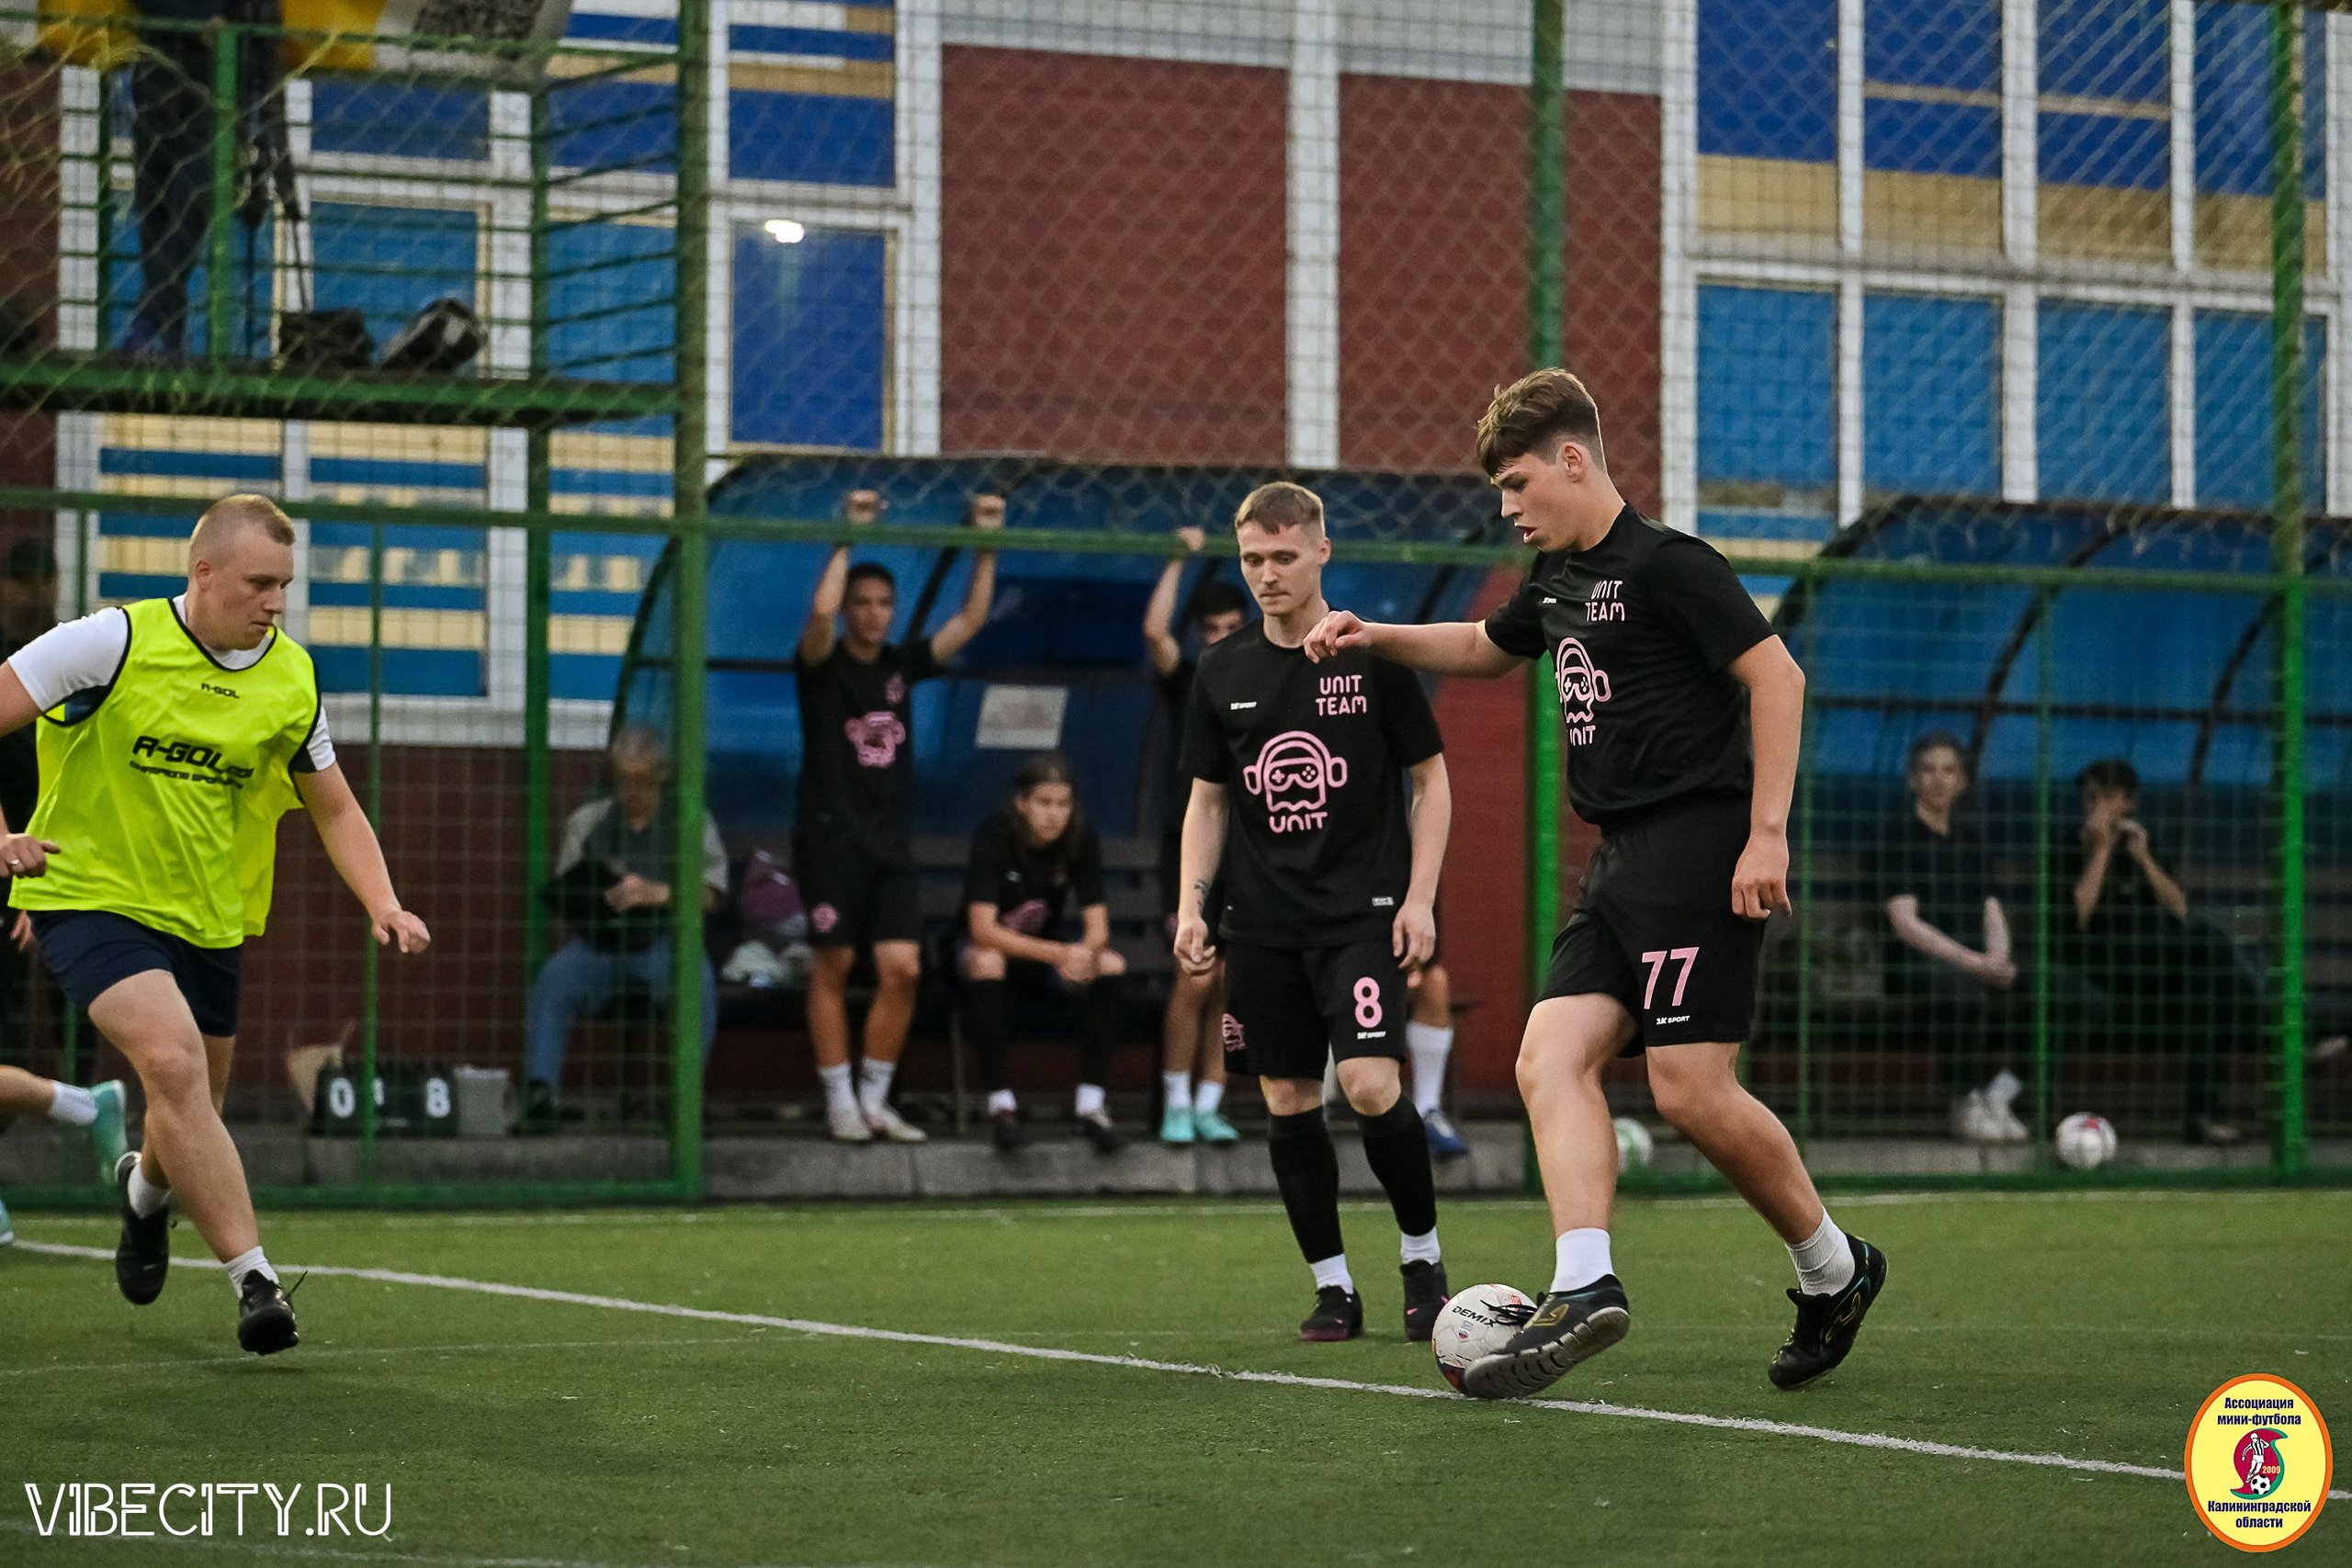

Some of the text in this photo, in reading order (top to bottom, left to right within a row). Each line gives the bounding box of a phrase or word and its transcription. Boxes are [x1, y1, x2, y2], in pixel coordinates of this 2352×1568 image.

[1591, 580, 1623, 600] UNIT
[1585, 602, 1625, 622] TEAM
[1320, 674, 1363, 695] UNIT
[1315, 695, 1367, 716] TEAM
[1269, 811, 1329, 833] UNIT
[1641, 946, 1700, 1010] 77
[1353, 976, 1383, 1029] 8
[1668, 1015, 1690, 1024] SPORT
[426, 1077, 451, 1119] 8
[1452, 1305, 1495, 1328] DEMIX
